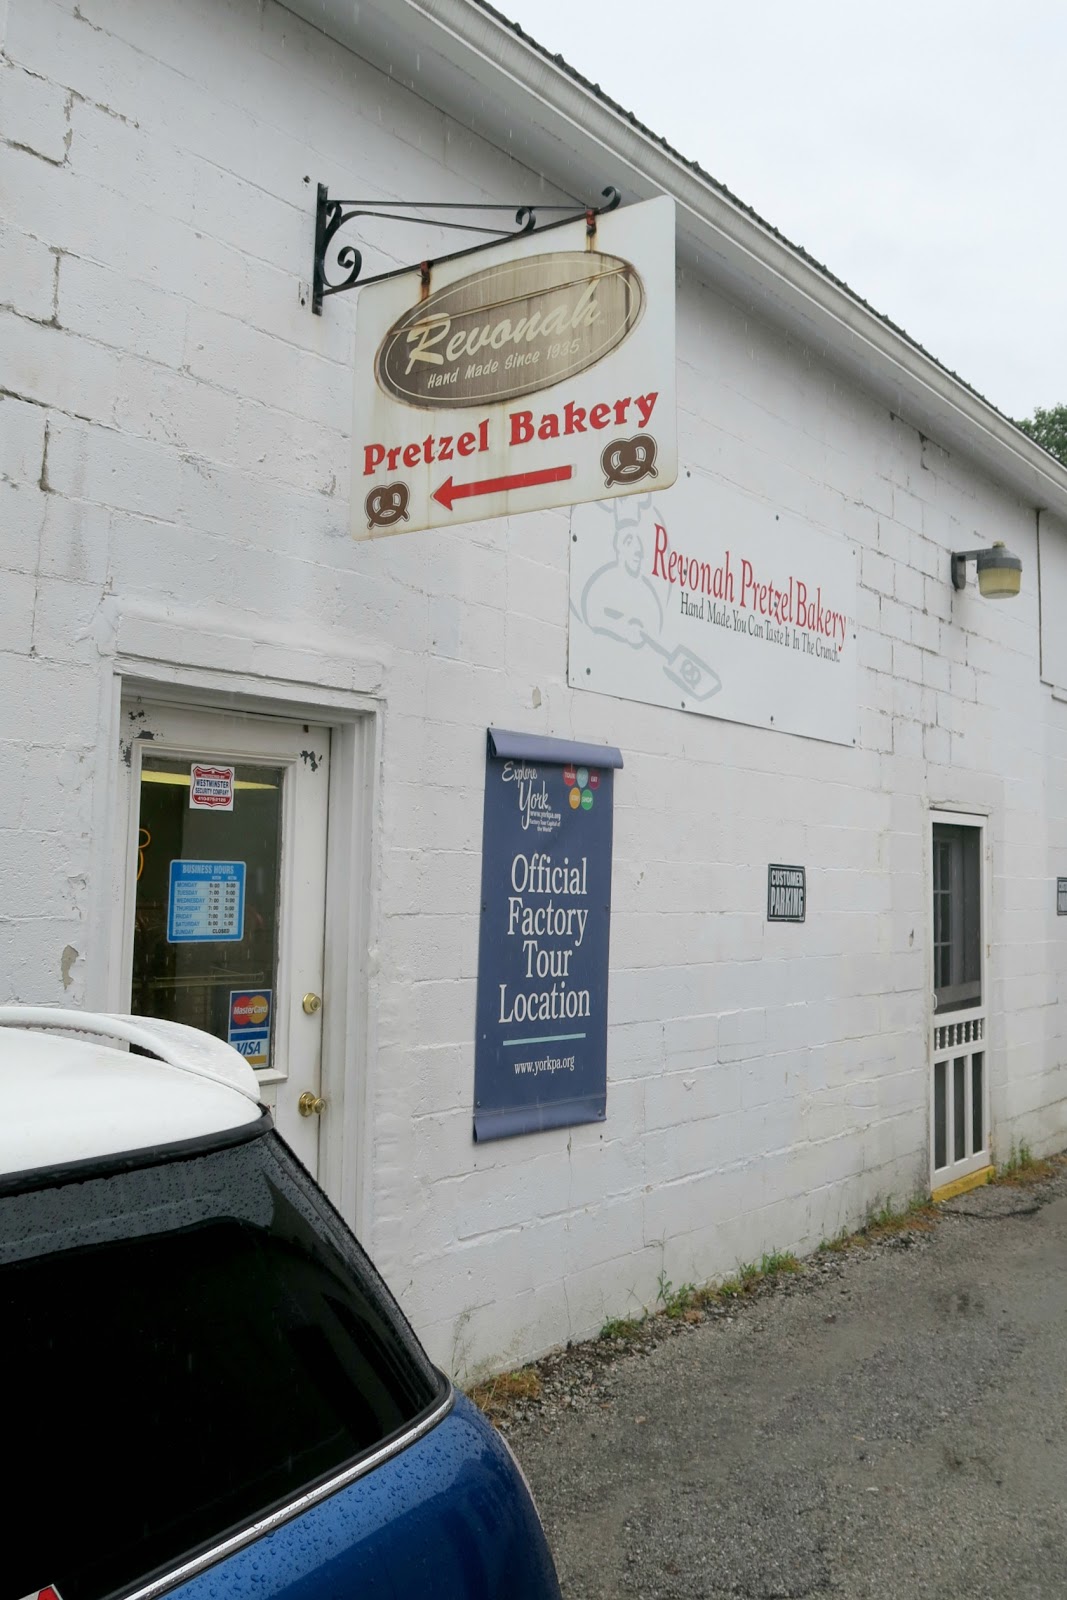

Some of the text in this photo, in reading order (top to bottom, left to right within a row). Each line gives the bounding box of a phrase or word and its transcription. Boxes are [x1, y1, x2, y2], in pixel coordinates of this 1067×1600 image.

[405, 279, 601, 374] Revonah
[427, 338, 581, 389] Hand Made Since 1935
[363, 392, 659, 476] Pretzel Bakery
[651, 523, 847, 652] Revonah Pretzel Bakery
[680, 591, 704, 620] Hand
[733, 609, 747, 633] You
[747, 614, 764, 639] Can
[765, 619, 784, 645] Taste
[784, 626, 790, 647] It
[792, 629, 800, 650] In
[801, 632, 815, 655] The
[196, 779, 229, 788] WESTMINSTER
[501, 761, 538, 788] Explore
[182, 864, 234, 874] BUSINESS HOURS
[511, 852, 588, 895] Official
[771, 870, 803, 887] CUSTOMER
[770, 887, 804, 916] PARKING
[507, 896, 589, 947] Factory
[522, 940, 573, 978] Tour
[233, 1005, 268, 1015] MasterCard
[498, 981, 591, 1024] Location
[236, 1041, 261, 1055] VISA
[514, 1055, 575, 1075] www.yorkpa.org
